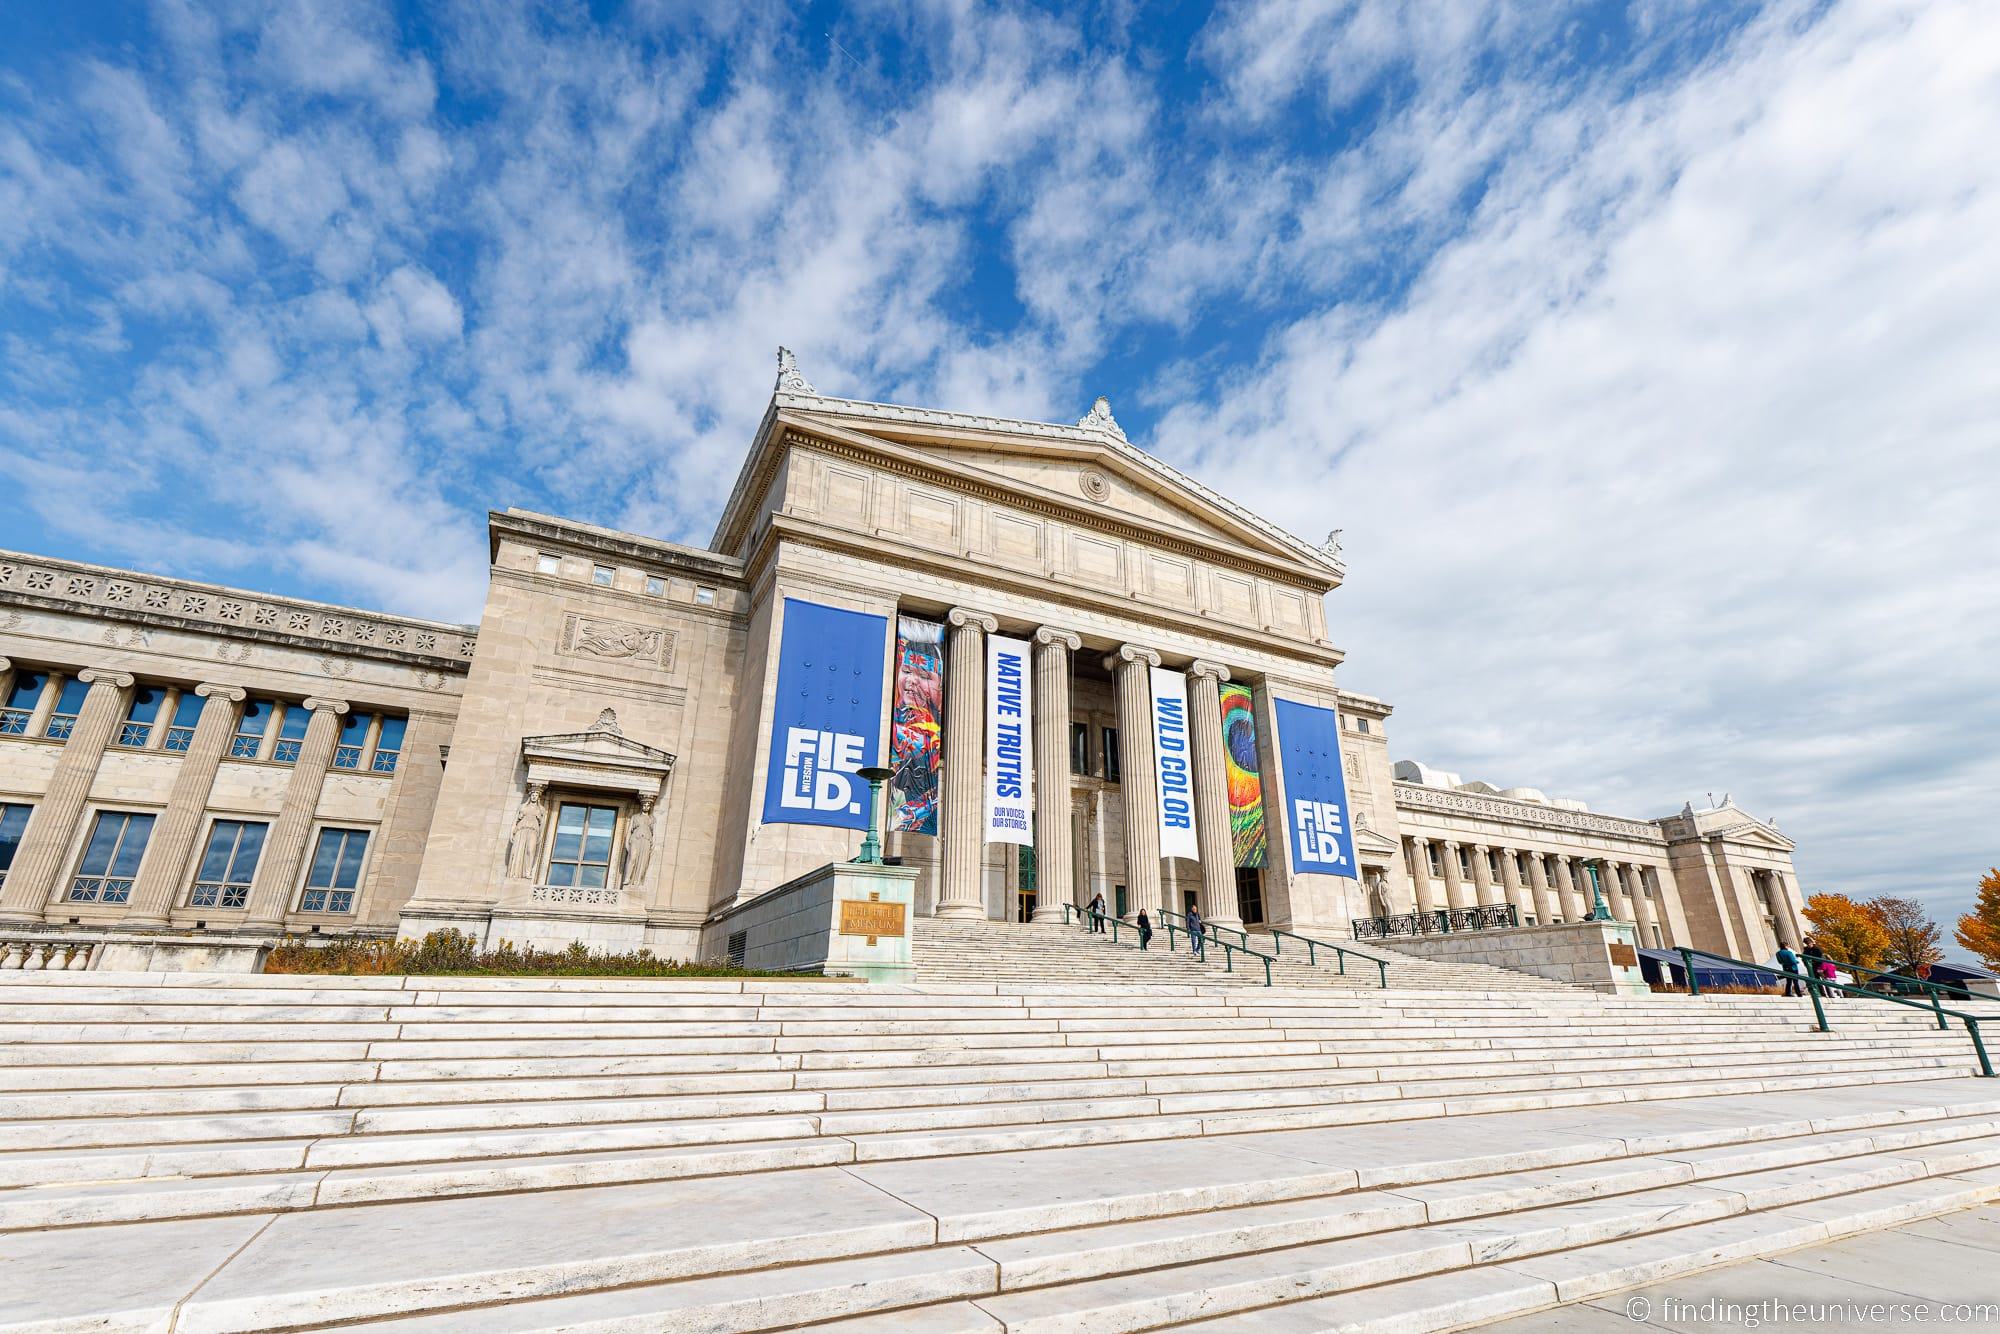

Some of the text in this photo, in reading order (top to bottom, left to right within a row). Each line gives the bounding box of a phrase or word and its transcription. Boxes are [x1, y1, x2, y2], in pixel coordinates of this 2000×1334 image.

[997, 652, 1022, 799] NATIVE TRUTHS
[801, 757, 813, 793] MUSEUM
[1156, 697, 1190, 830] WILD COLOR
[992, 818, 1027, 830] OUR STORIES
[994, 806, 1025, 819] OUR VOICES
